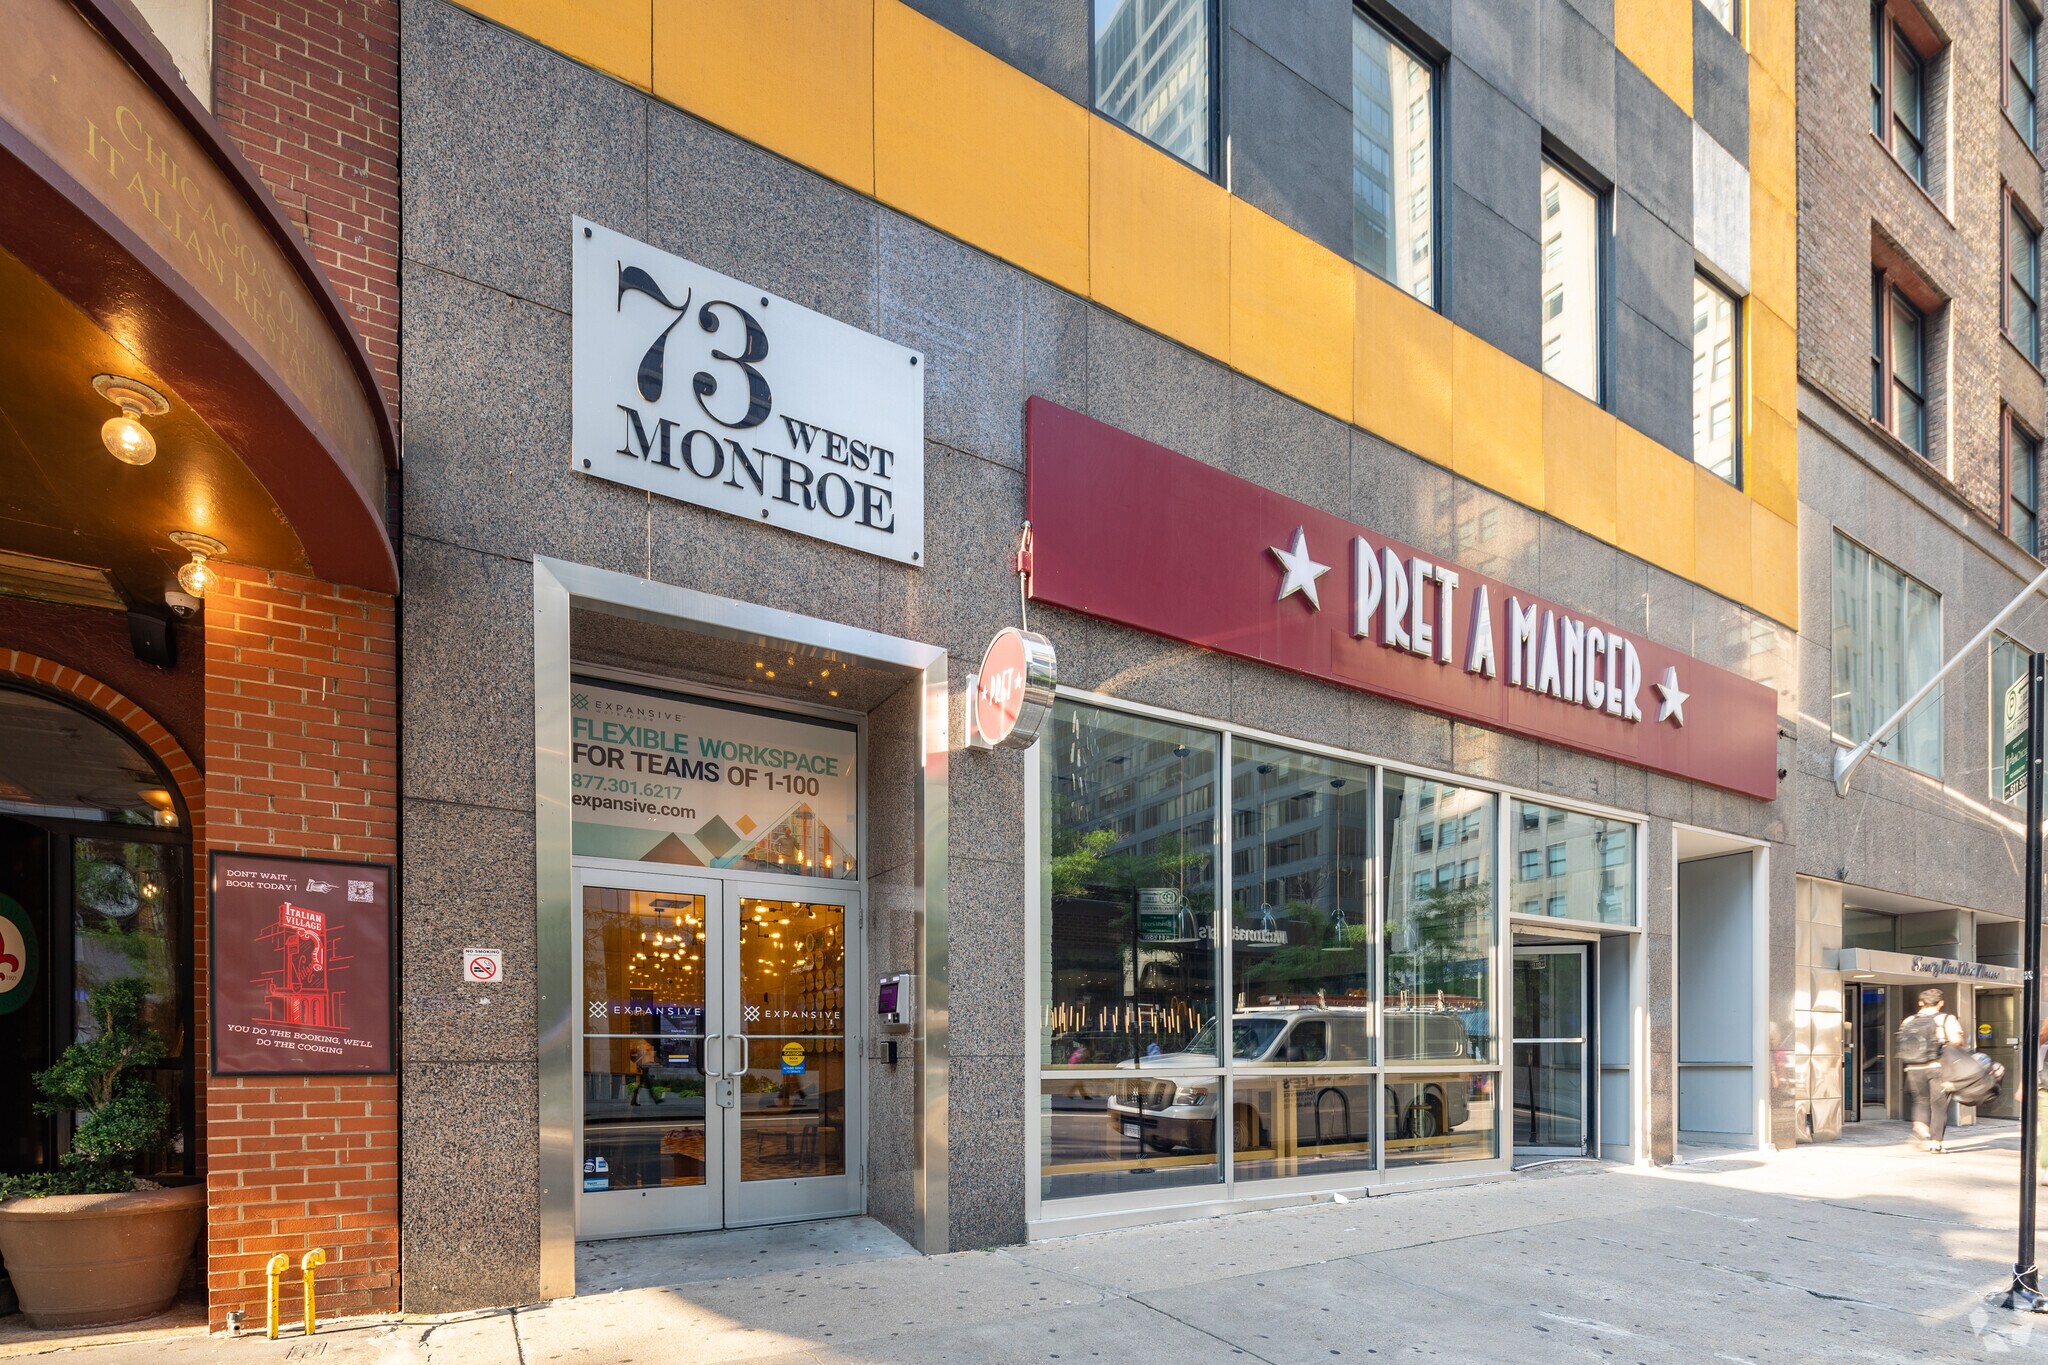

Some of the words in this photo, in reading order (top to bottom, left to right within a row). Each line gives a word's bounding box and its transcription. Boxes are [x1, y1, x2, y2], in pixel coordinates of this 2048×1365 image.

[85, 117, 225, 286] ITALIAN
[115, 105, 272, 299] CHICAGO'S
[617, 259, 773, 430] 73
[779, 414, 895, 480] WEST
[616, 404, 895, 534] MONROE
[1353, 534, 1460, 665] PRET
[1465, 584, 1497, 679] A
[1507, 594, 1643, 723] MANGER
[989, 667, 1015, 706] PRET
[595, 701, 681, 722] EXPANSIVE
[572, 717, 689, 754] FLEXIBLE
[698, 736, 839, 777] WORKSPACE
[572, 742, 624, 770] FOR
[630, 750, 720, 782] TEAMS
[727, 766, 758, 787] OF
[764, 772, 820, 797] 1-100
[572, 773, 682, 800] 877.301.6217
[571, 793, 696, 819] expansive.com
[225, 880, 255, 888] BOOK
[256, 882, 292, 891] TODAY
[260, 872, 288, 881] WAIT
[284, 901, 322, 923] ITALIAN
[285, 915, 322, 931] VILLAGE
[613, 1005, 701, 1016] EXPANSIVE
[765, 1010, 840, 1019] EXPANSIVE
[227, 1024, 250, 1033] YOU
[252, 1027, 268, 1035] DO
[270, 1029, 291, 1038] THE
[293, 1032, 341, 1045] BOOKING,
[256, 1038, 272, 1046] DO
[274, 1040, 295, 1049] THE
[297, 1043, 343, 1055] COOKING
